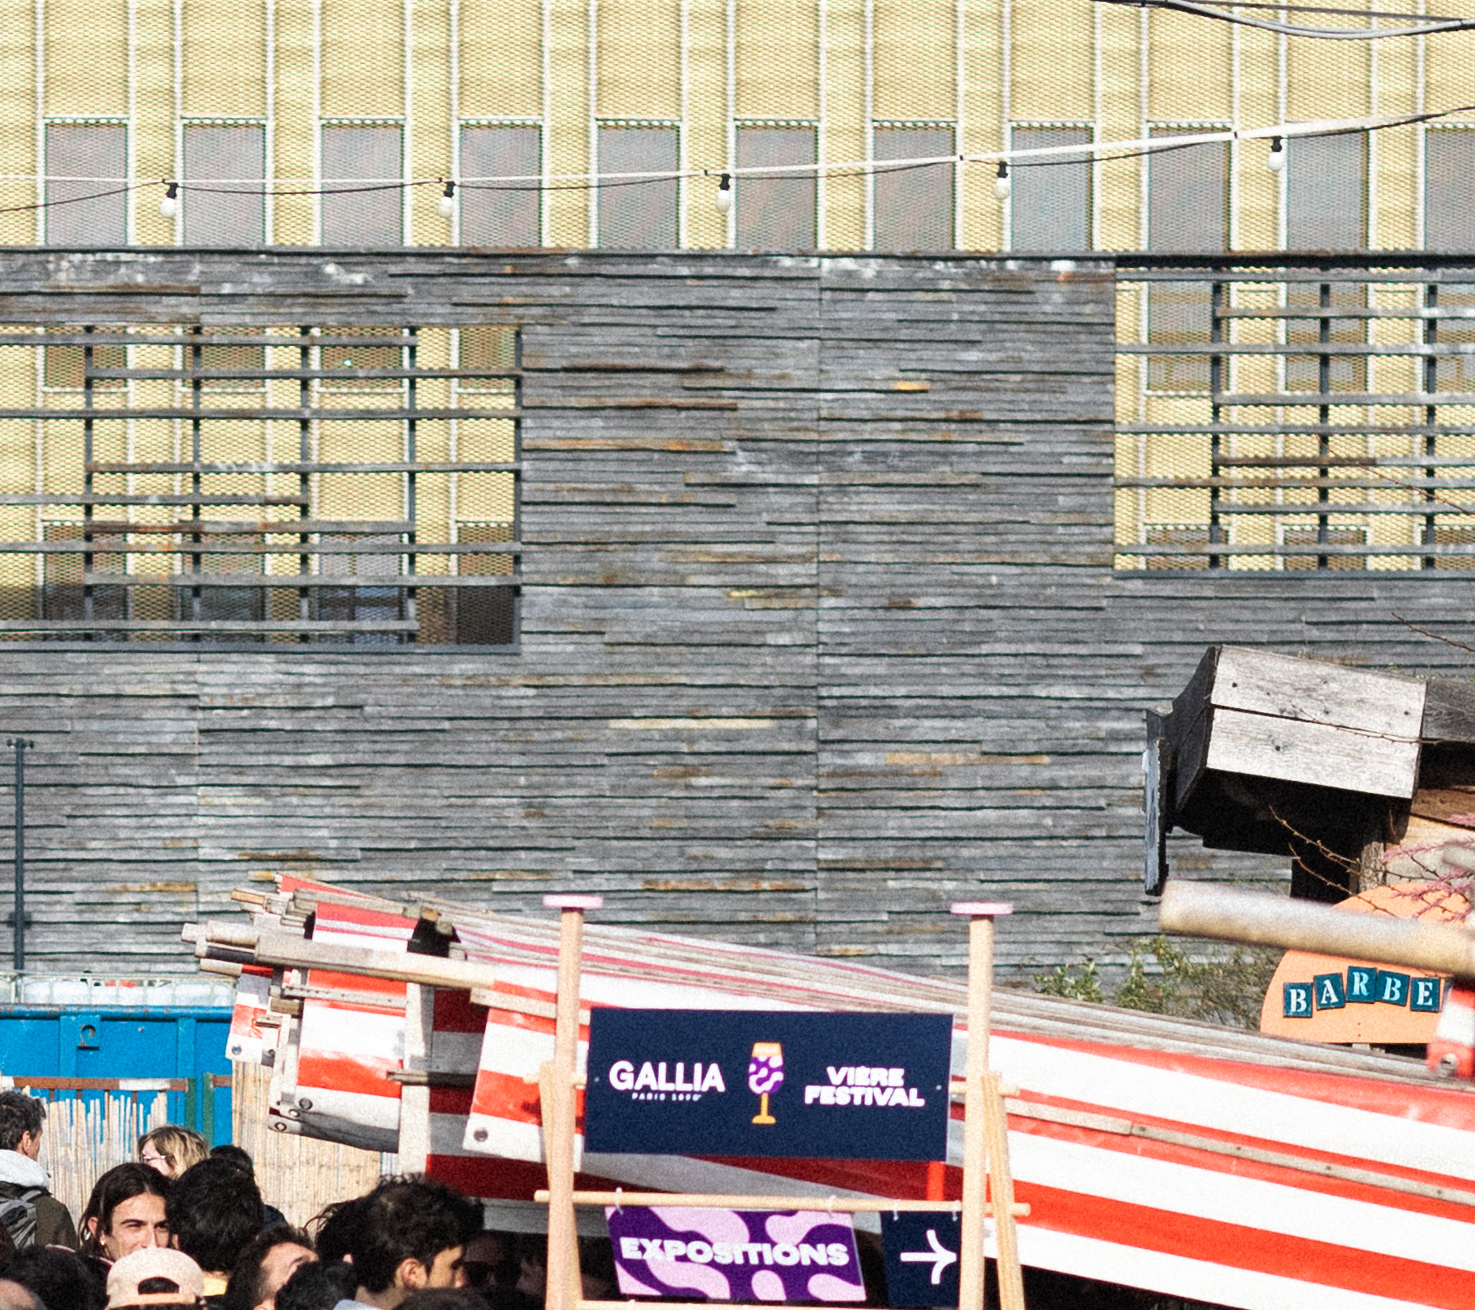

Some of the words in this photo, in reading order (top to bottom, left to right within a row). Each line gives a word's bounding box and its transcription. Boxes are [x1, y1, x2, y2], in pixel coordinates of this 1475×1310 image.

[1289, 971, 1434, 1013] BARBE
[608, 1060, 726, 1092] GALLIA
[804, 1085, 926, 1107] FESTIVAL
[619, 1236, 850, 1267] EXPOSITIONS
